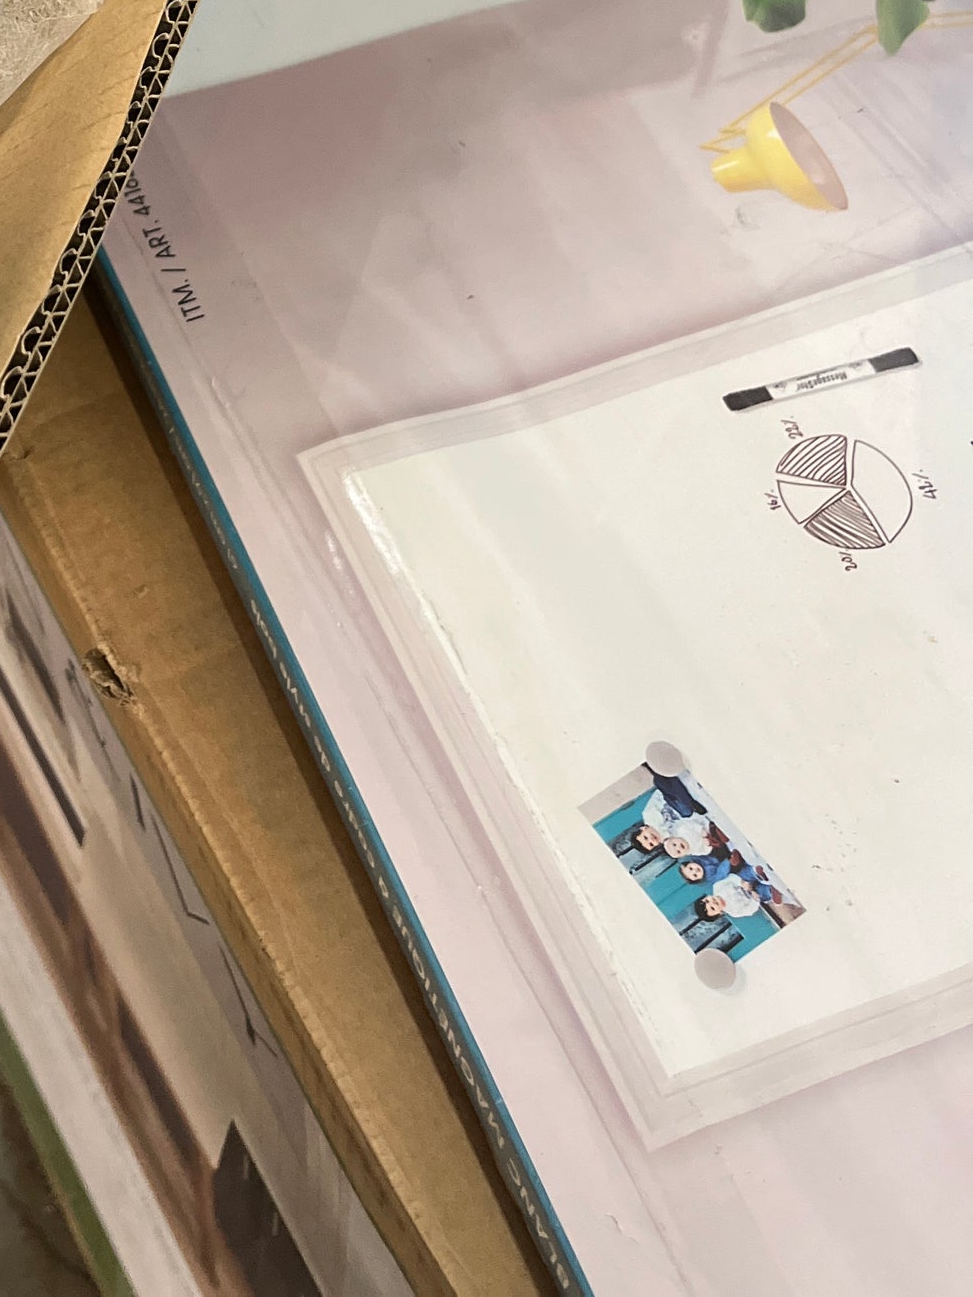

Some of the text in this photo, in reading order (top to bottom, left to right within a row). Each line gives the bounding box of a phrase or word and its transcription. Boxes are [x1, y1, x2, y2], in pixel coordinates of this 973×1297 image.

[142, 219, 176, 258] ART.
[172, 279, 205, 322] ITM.
[506, 1157, 570, 1289] BLANC
